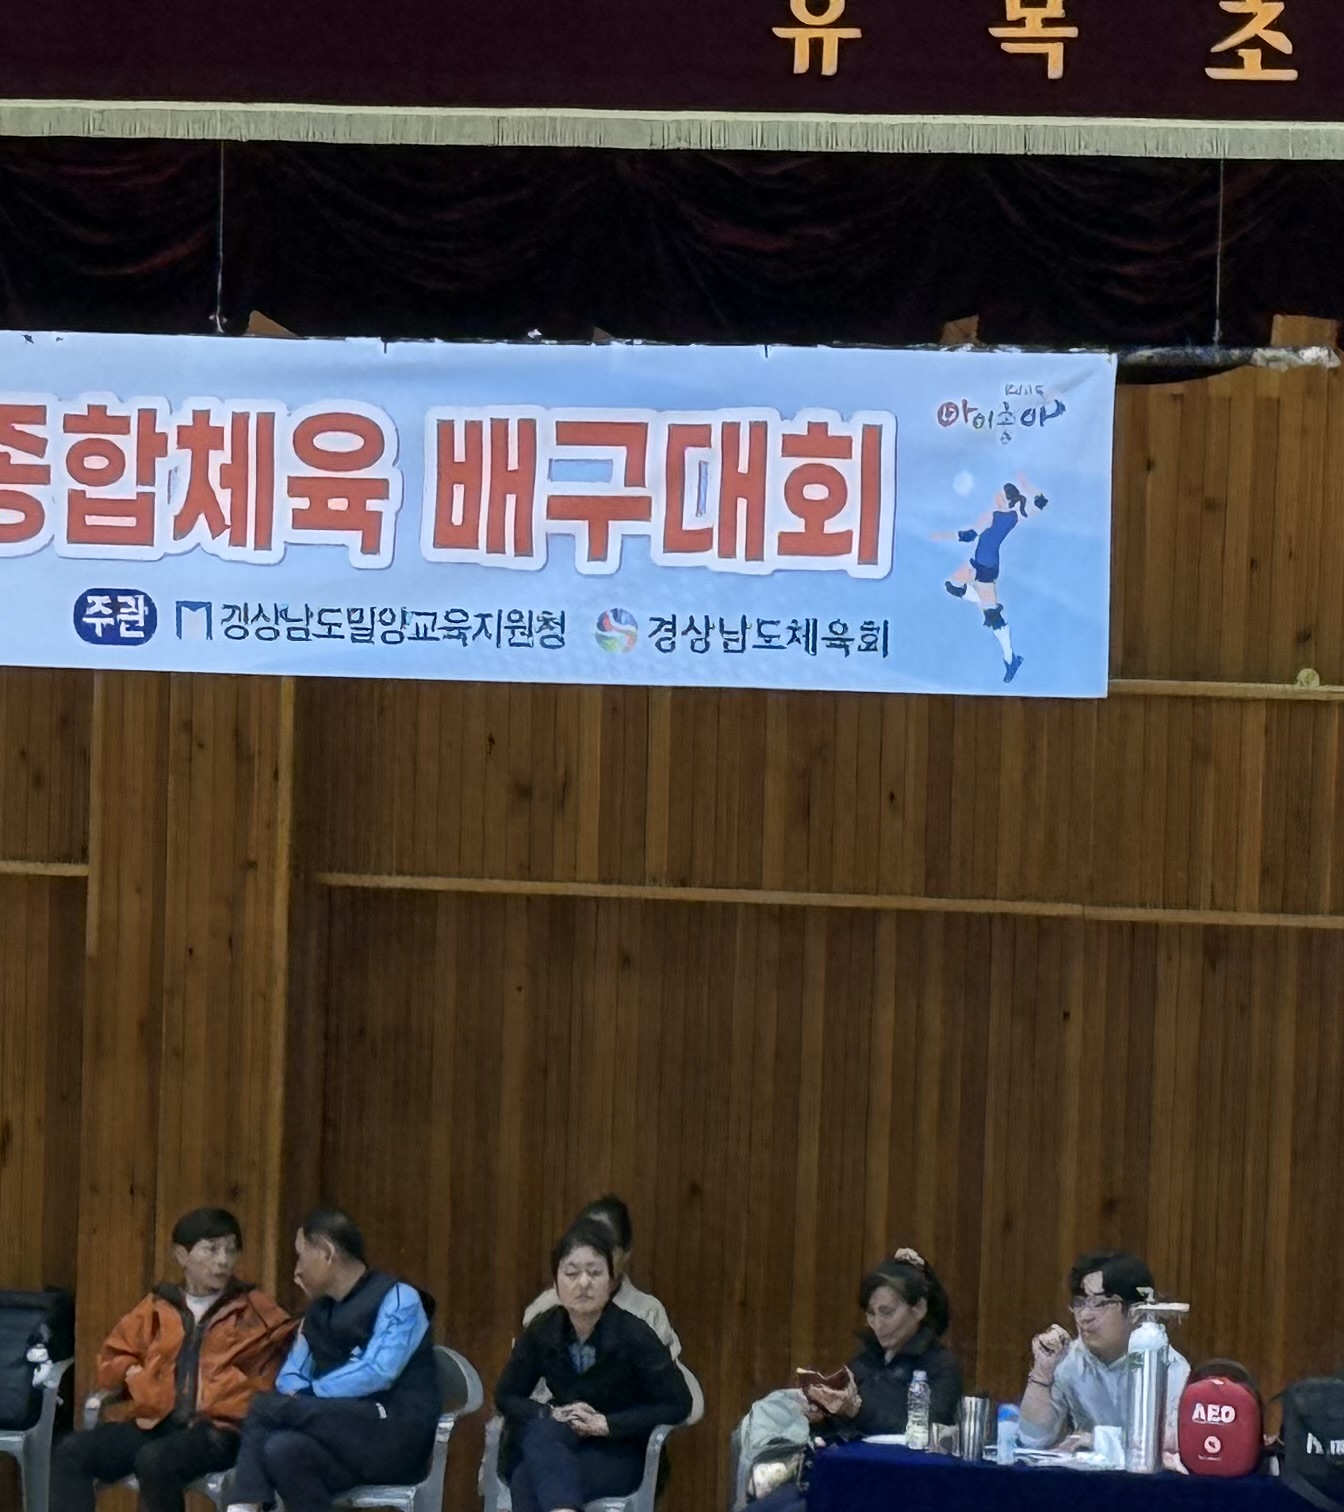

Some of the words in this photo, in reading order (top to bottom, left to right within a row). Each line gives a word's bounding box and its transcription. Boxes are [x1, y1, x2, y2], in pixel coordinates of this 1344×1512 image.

[432, 418, 881, 566] 배구대회
[81, 593, 147, 639] 주관
[220, 602, 567, 649] 경상남도밀양교육지원청
[648, 613, 890, 658] 경상남도체육회
[1191, 1402, 1236, 1424] AED
